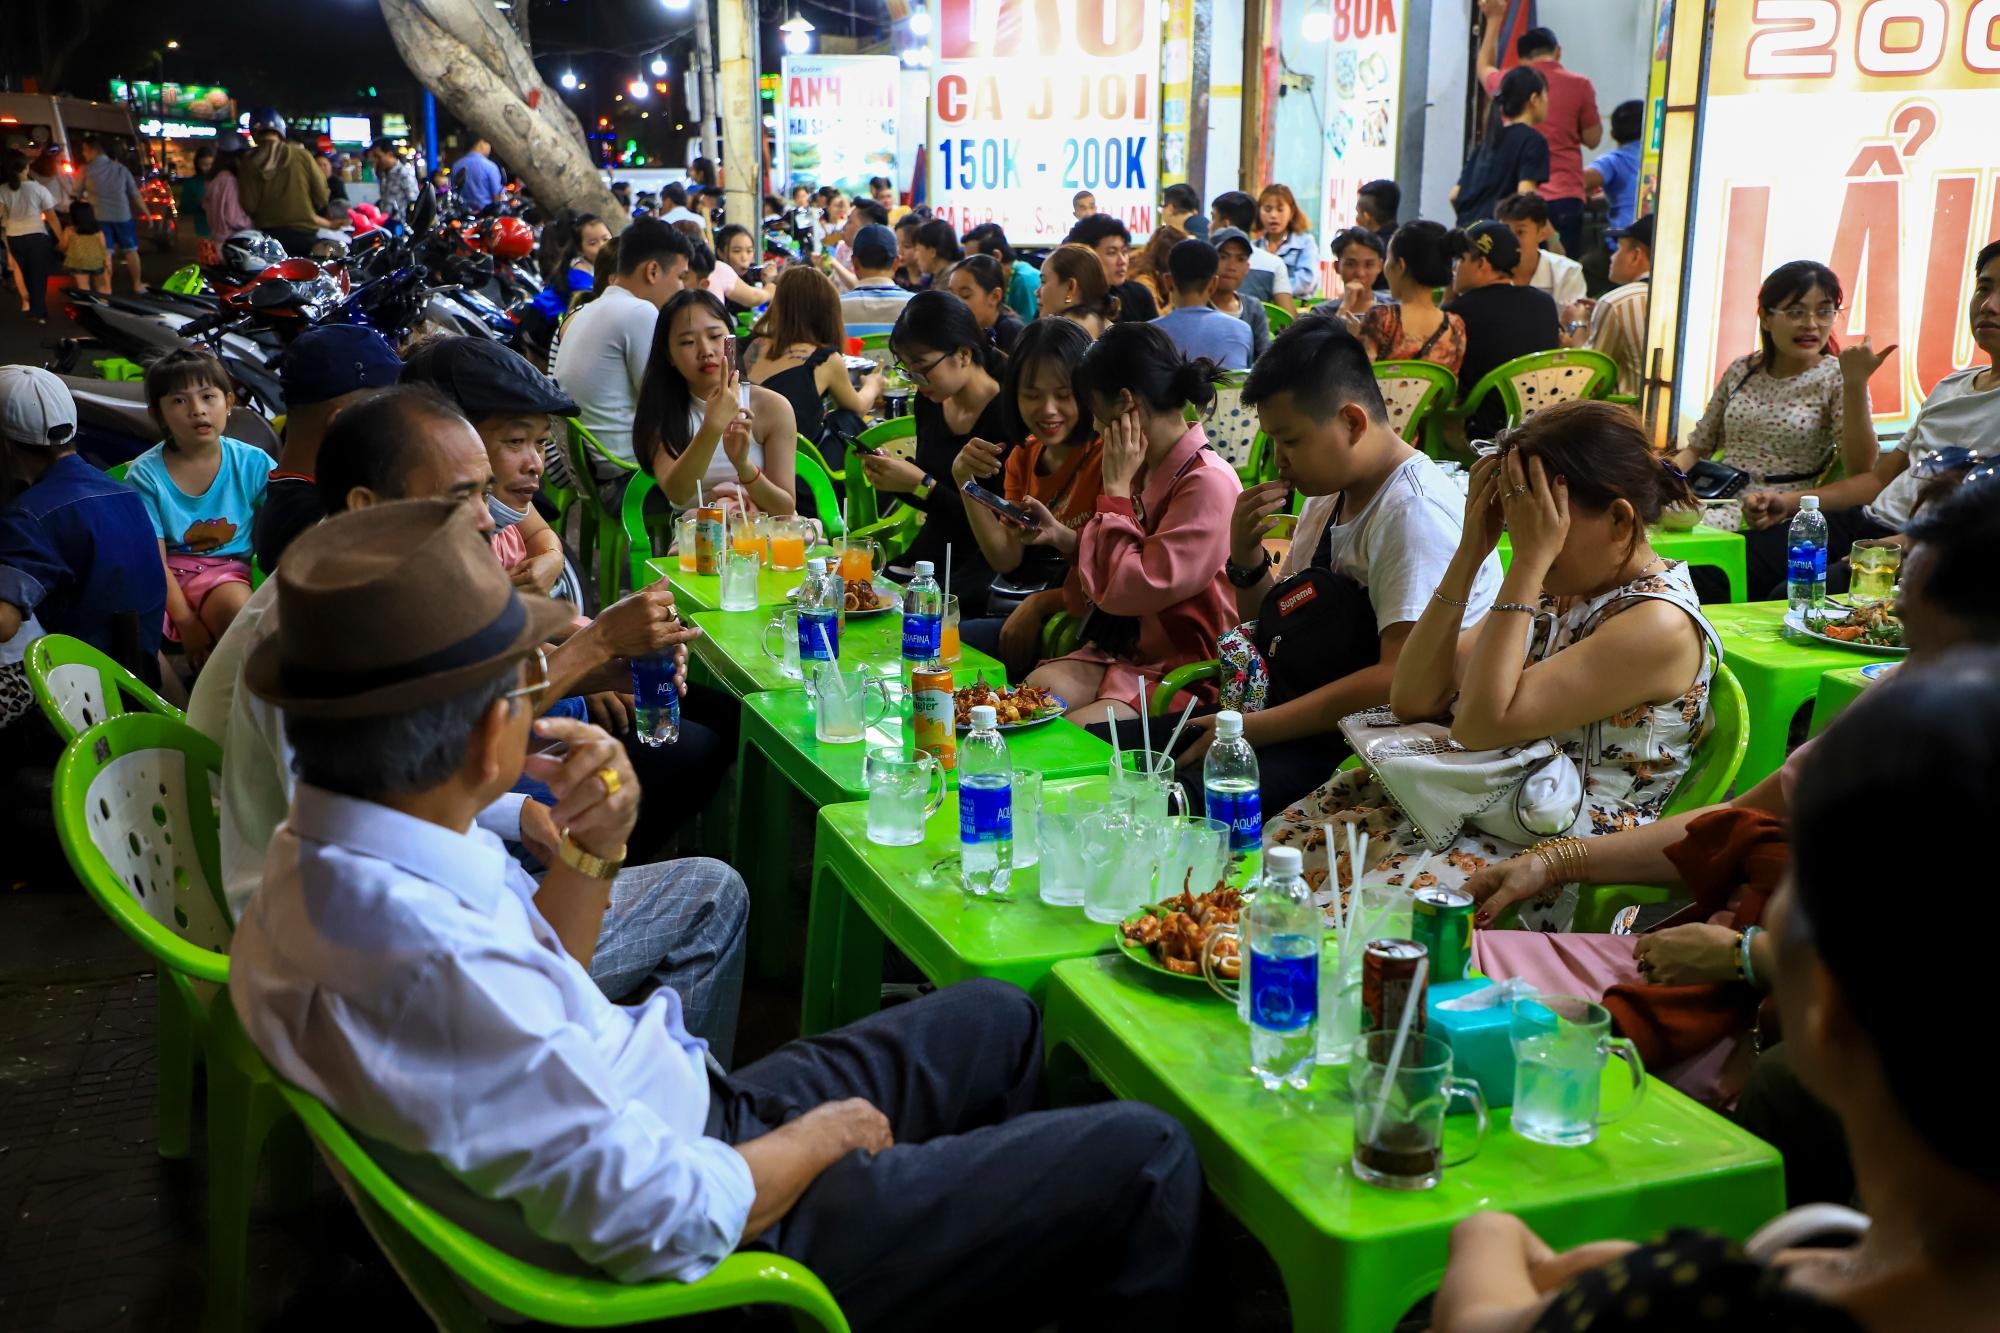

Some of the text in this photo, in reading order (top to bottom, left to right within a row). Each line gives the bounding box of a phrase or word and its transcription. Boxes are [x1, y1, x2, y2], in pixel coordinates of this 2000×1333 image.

[938, 137, 1022, 191] 150K
[1061, 137, 1148, 190] 200K
[1279, 587, 1313, 611] Supreme
